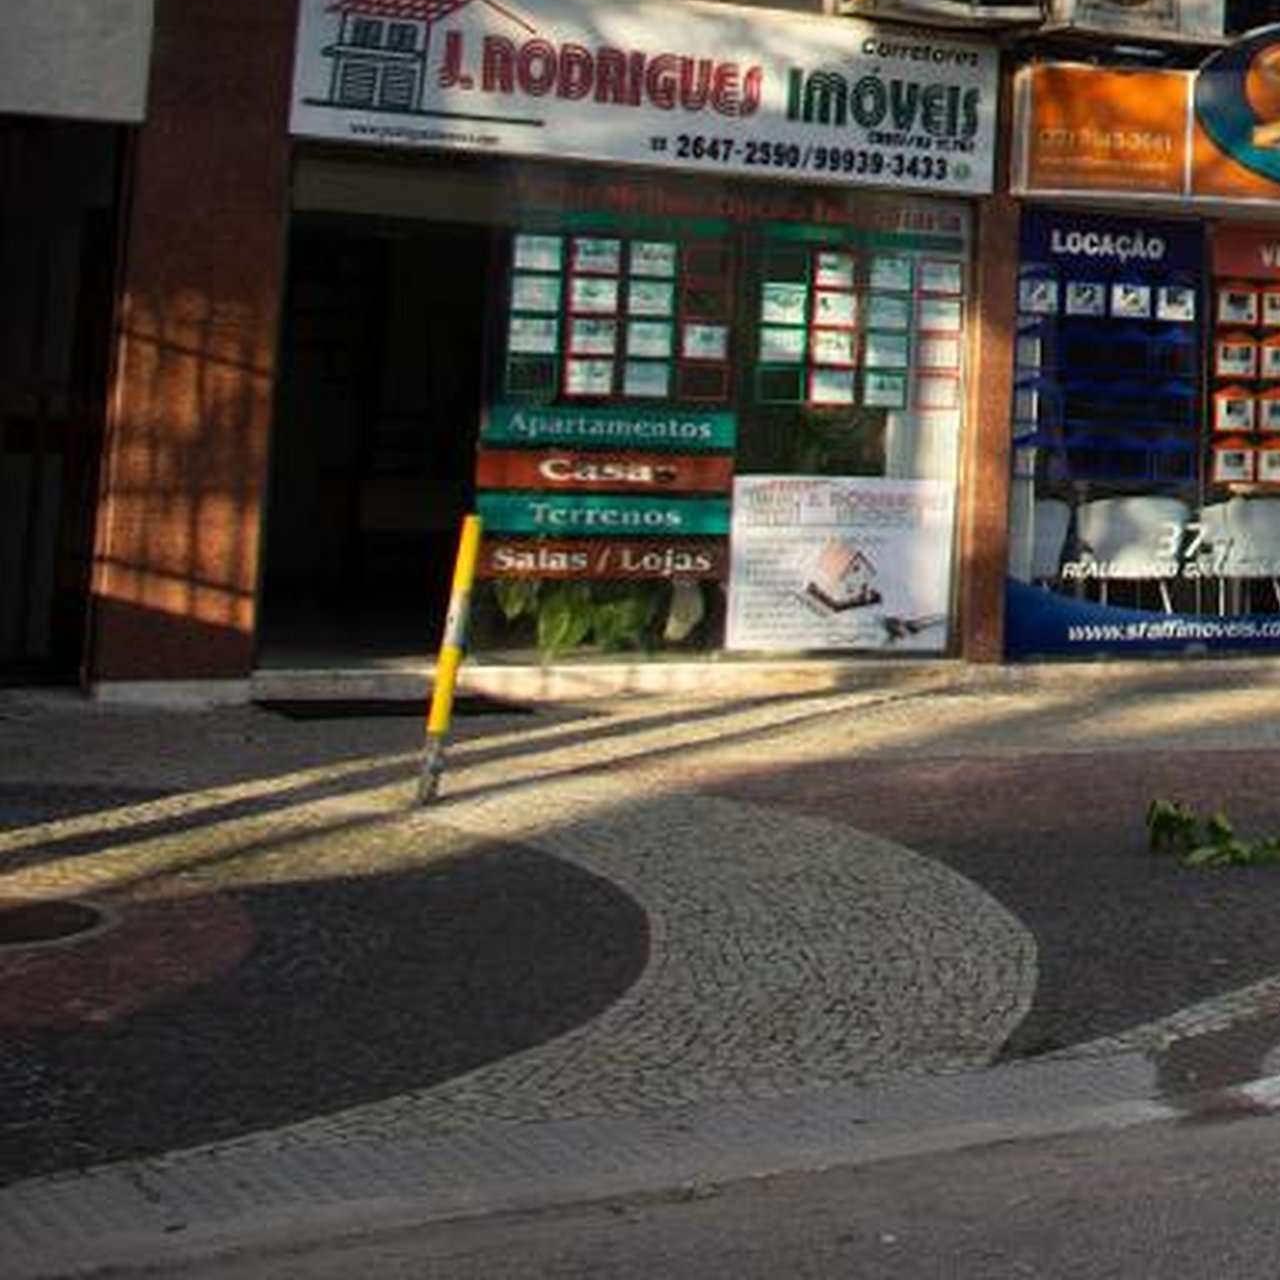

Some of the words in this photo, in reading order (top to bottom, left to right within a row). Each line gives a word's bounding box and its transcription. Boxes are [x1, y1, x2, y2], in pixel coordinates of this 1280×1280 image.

[437, 29, 473, 90] J.
[481, 34, 764, 118] RODRIGUES
[786, 66, 982, 139] IMÓVEIS
[1051, 230, 1166, 263] LOCAÇÃO
[507, 411, 713, 440] Apartamentos
[538, 457, 678, 483] Casas
[528, 502, 683, 527] Terrenos
[493, 546, 589, 571] Salas
[620, 548, 713, 576] Lojas
